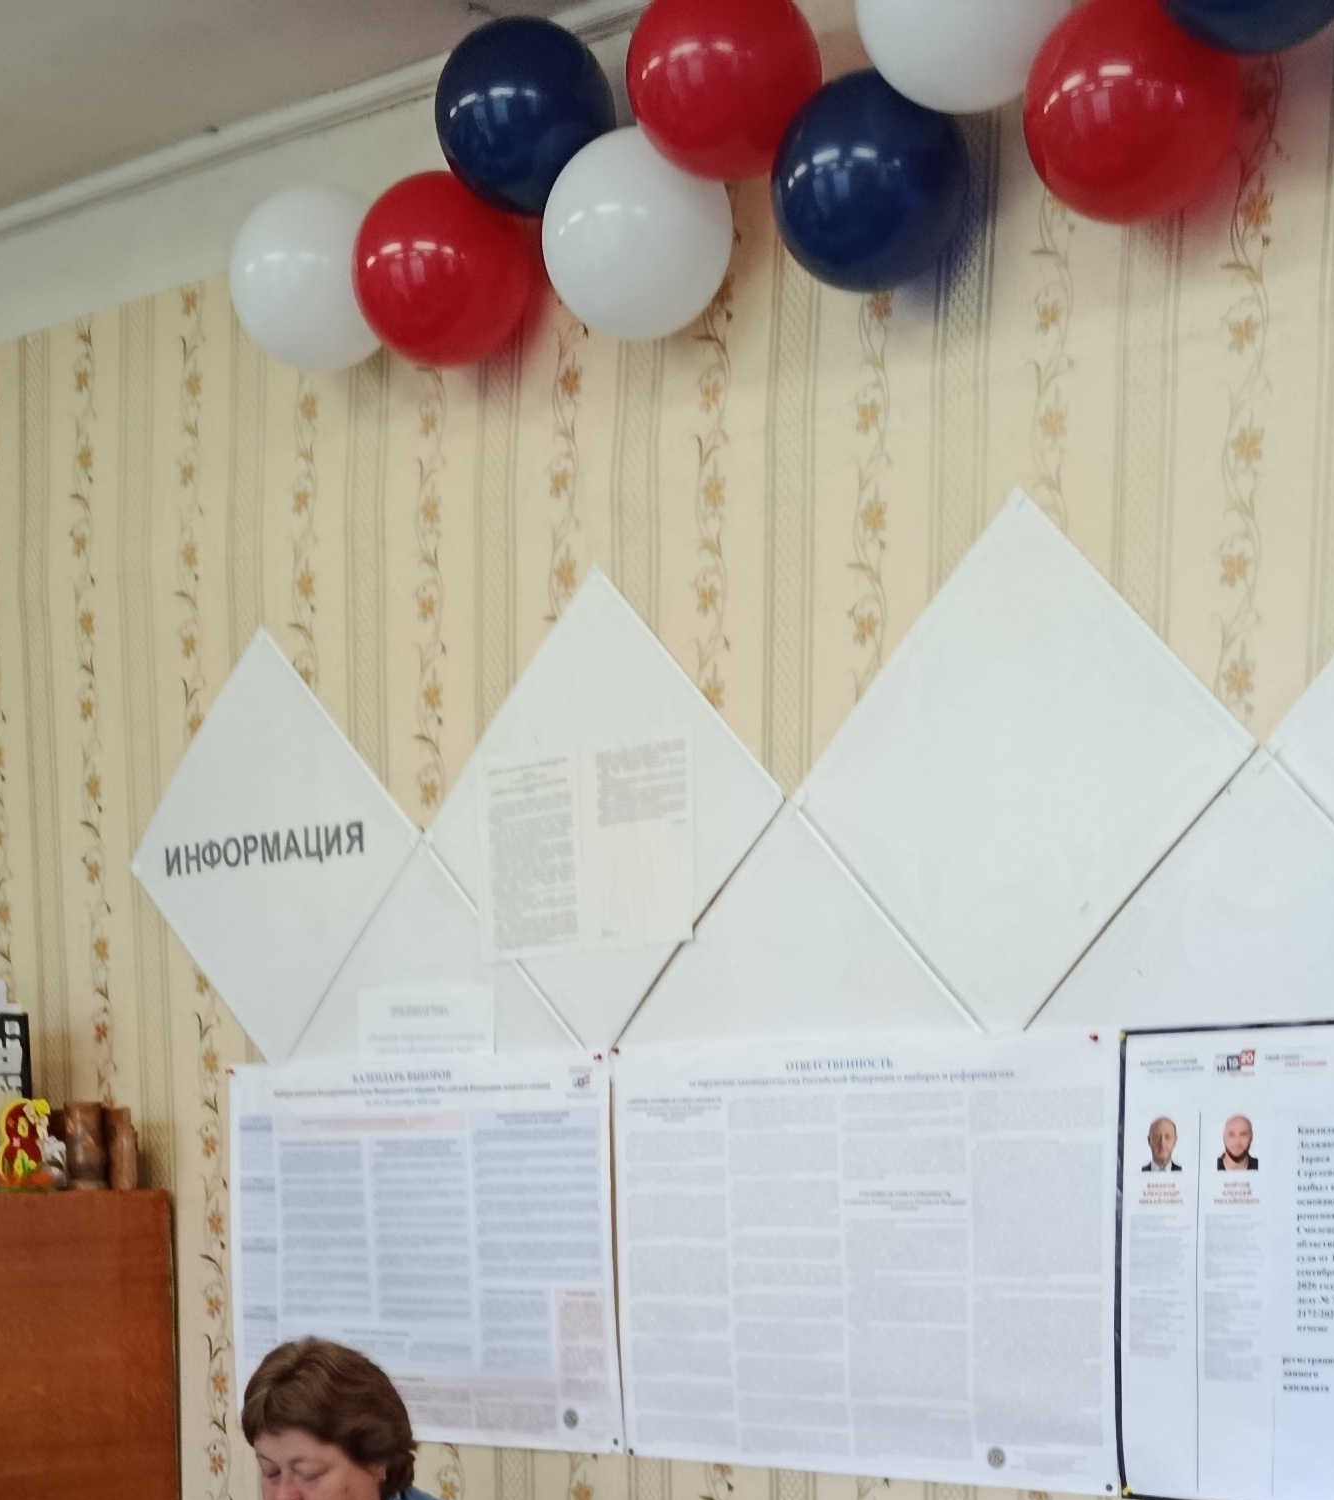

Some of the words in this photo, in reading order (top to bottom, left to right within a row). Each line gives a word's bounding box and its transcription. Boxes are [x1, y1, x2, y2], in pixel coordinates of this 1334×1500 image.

[165, 821, 364, 877] ИНФОРМАЦИЯ
[785, 1057, 893, 1072] ОТВЕТСТВЕННОСТЬ
[352, 1071, 405, 1084] КАЛЕНДАРЬ
[407, 1069, 452, 1081] ВЫБОРОВ
[950, 1070, 1015, 1083] референдумах
[1297, 1281, 1317, 1290] 2026
